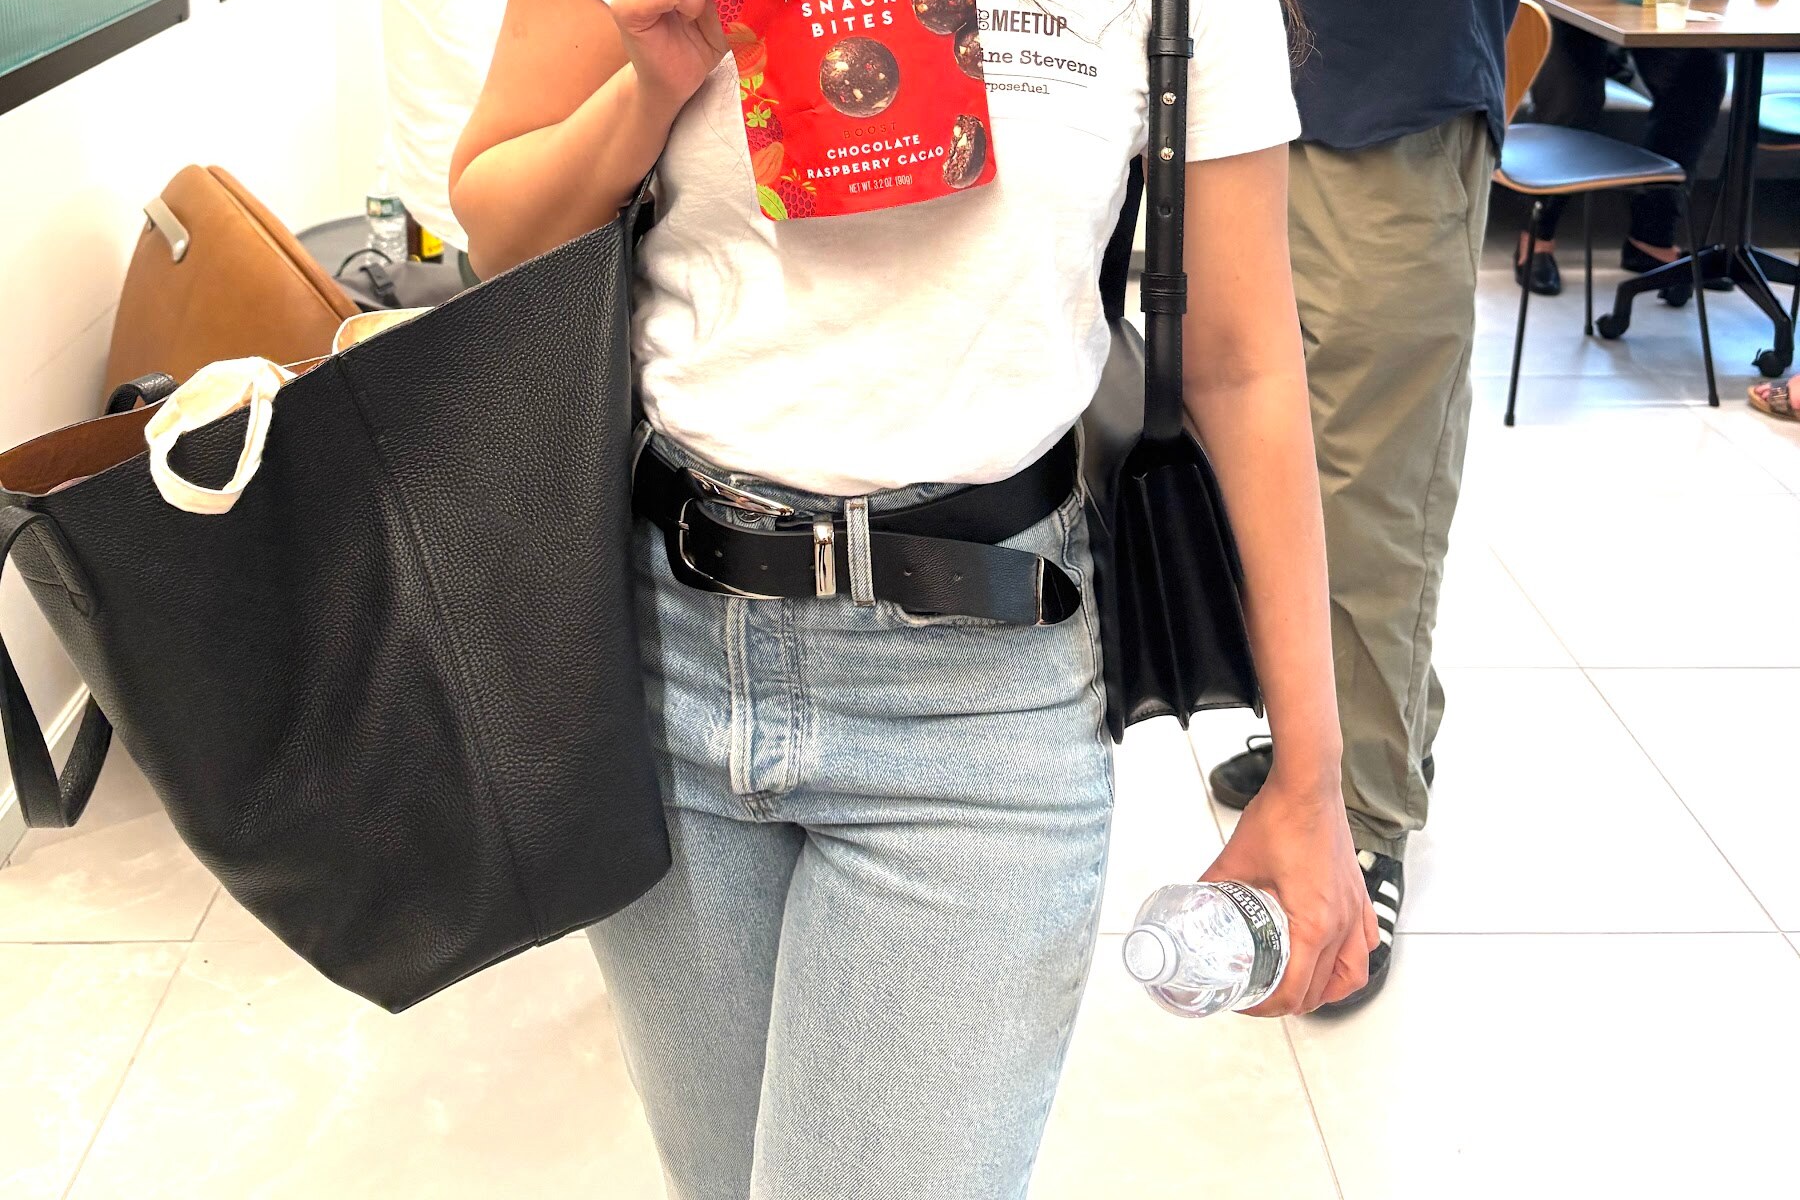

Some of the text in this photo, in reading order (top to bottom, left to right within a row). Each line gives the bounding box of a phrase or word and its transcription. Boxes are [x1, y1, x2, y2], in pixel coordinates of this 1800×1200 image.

[811, 10, 893, 38] BITES
[991, 9, 1067, 37] MEETUP
[981, 48, 1098, 77] ine Stevens
[984, 81, 1050, 95] rposefuel
[843, 122, 896, 138] BOOST
[827, 134, 920, 159] CHOCOLATE
[807, 146, 944, 179] RASPBERRY CACAO
[849, 182, 860, 193] NET
